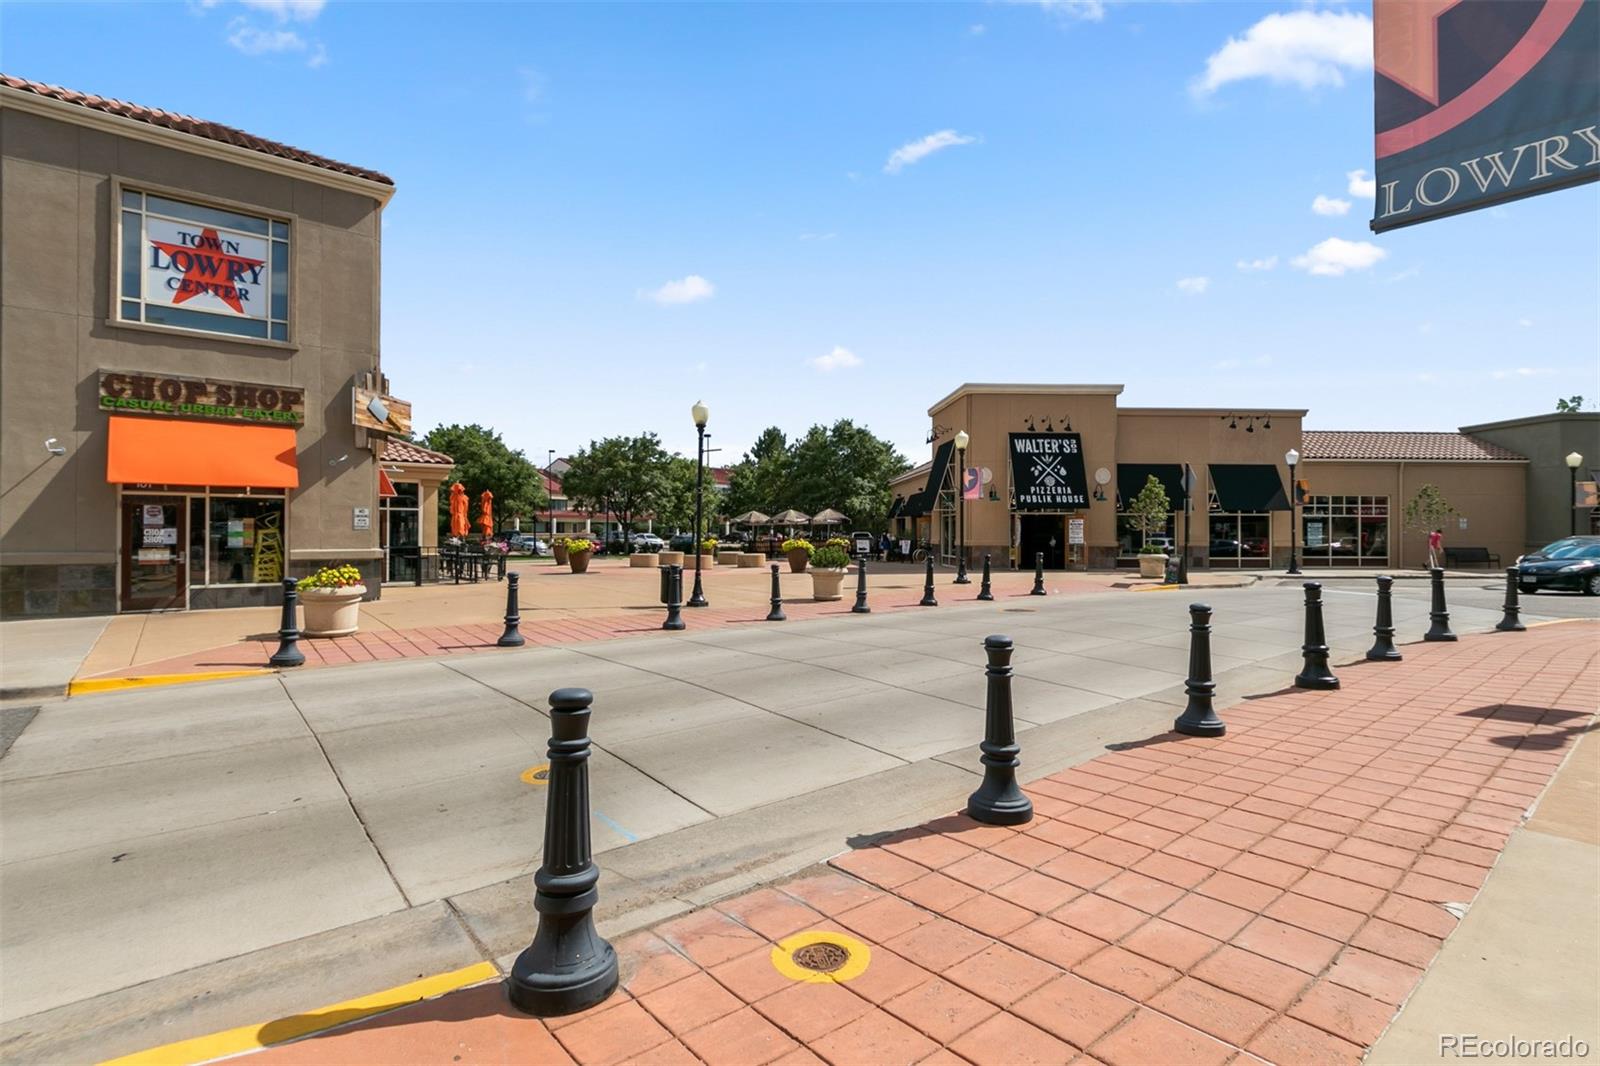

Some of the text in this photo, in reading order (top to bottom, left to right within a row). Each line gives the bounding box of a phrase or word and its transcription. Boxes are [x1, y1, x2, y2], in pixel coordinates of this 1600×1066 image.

[1380, 125, 1600, 218] LOWRY
[177, 231, 240, 254] TOWN
[150, 246, 265, 286] LOWRY
[167, 276, 249, 301] CENTER
[101, 372, 302, 412] CHOP SHOP
[100, 395, 302, 422] CASUAL URBAN EATERY
[1014, 438, 1070, 454] WALTER'S
[1020, 495, 1085, 504] PUBLIK HOUSE
[1030, 486, 1072, 495] PIZZERIA
